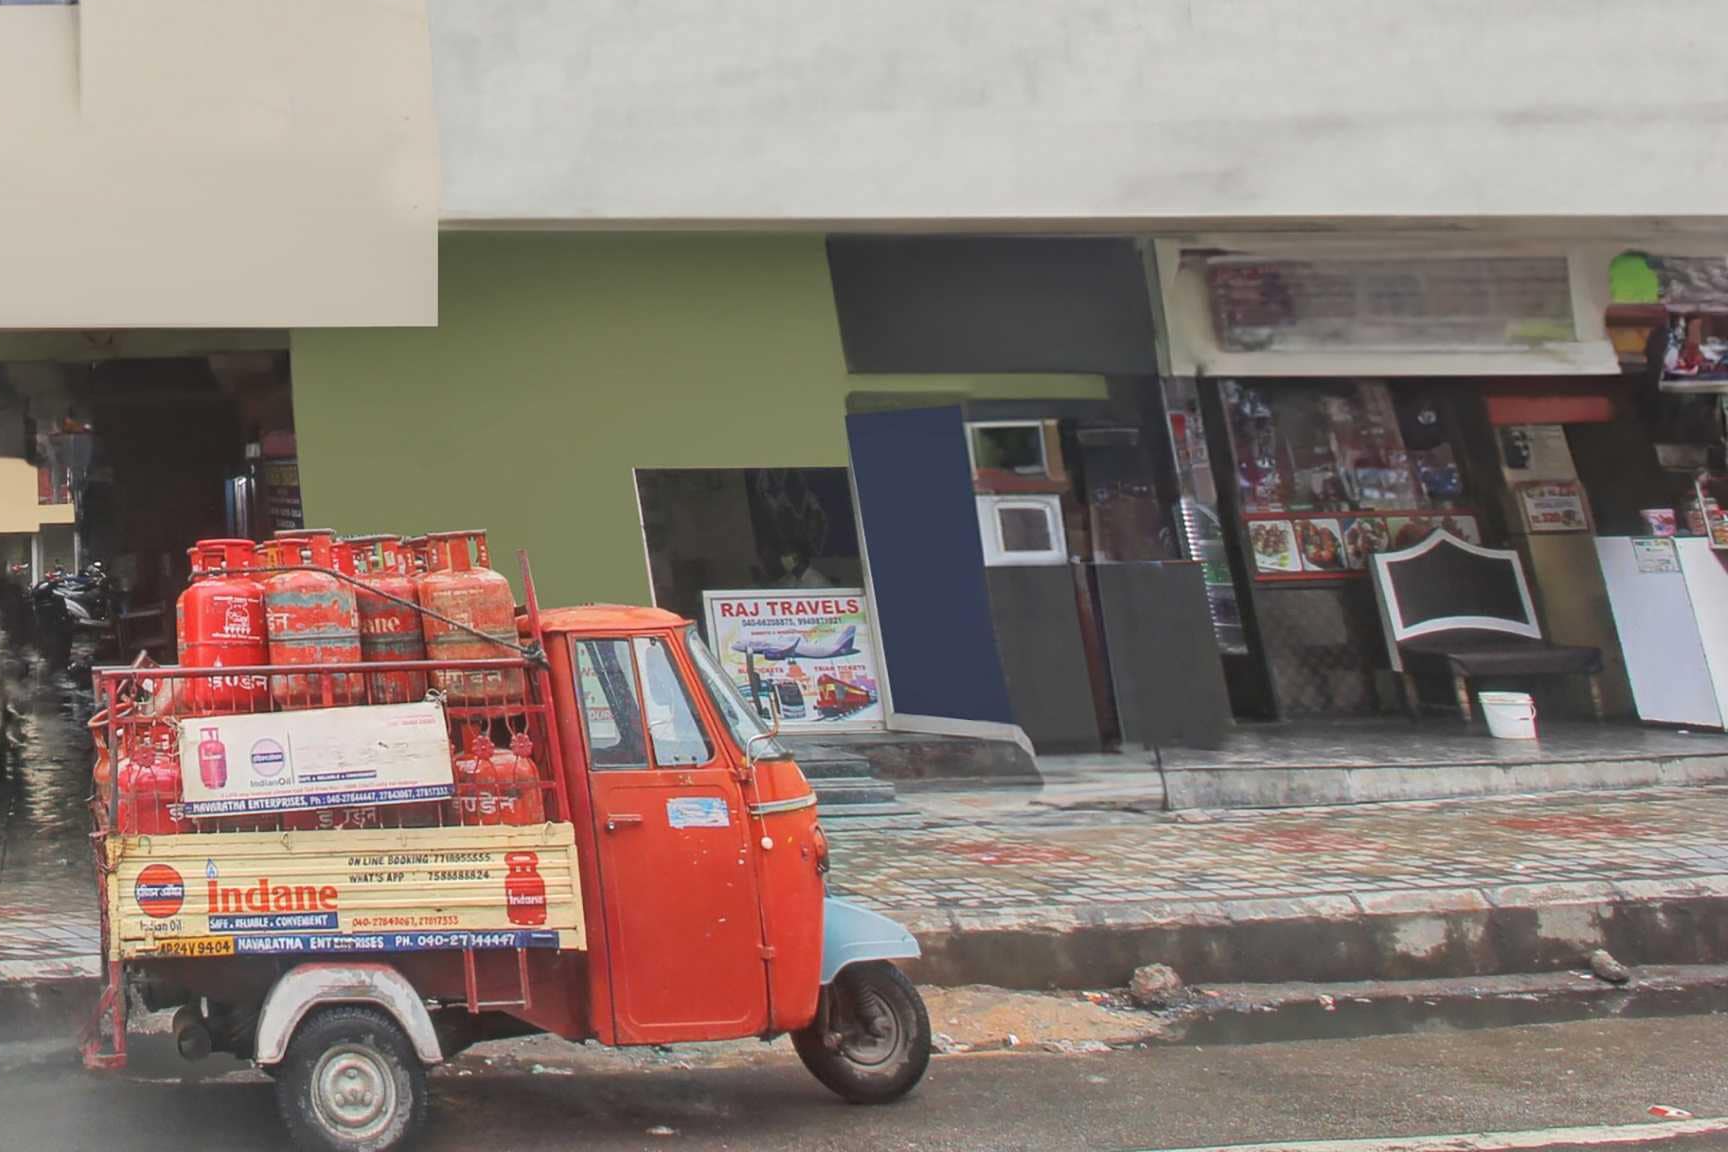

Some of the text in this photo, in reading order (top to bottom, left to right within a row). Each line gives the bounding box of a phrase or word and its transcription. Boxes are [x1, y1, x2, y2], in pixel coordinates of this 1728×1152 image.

[720, 599, 859, 617] RAJ TRAVELS
[207, 878, 338, 913] Indane
[169, 919, 182, 932] Oil
[238, 936, 303, 952] NAVARATNA
